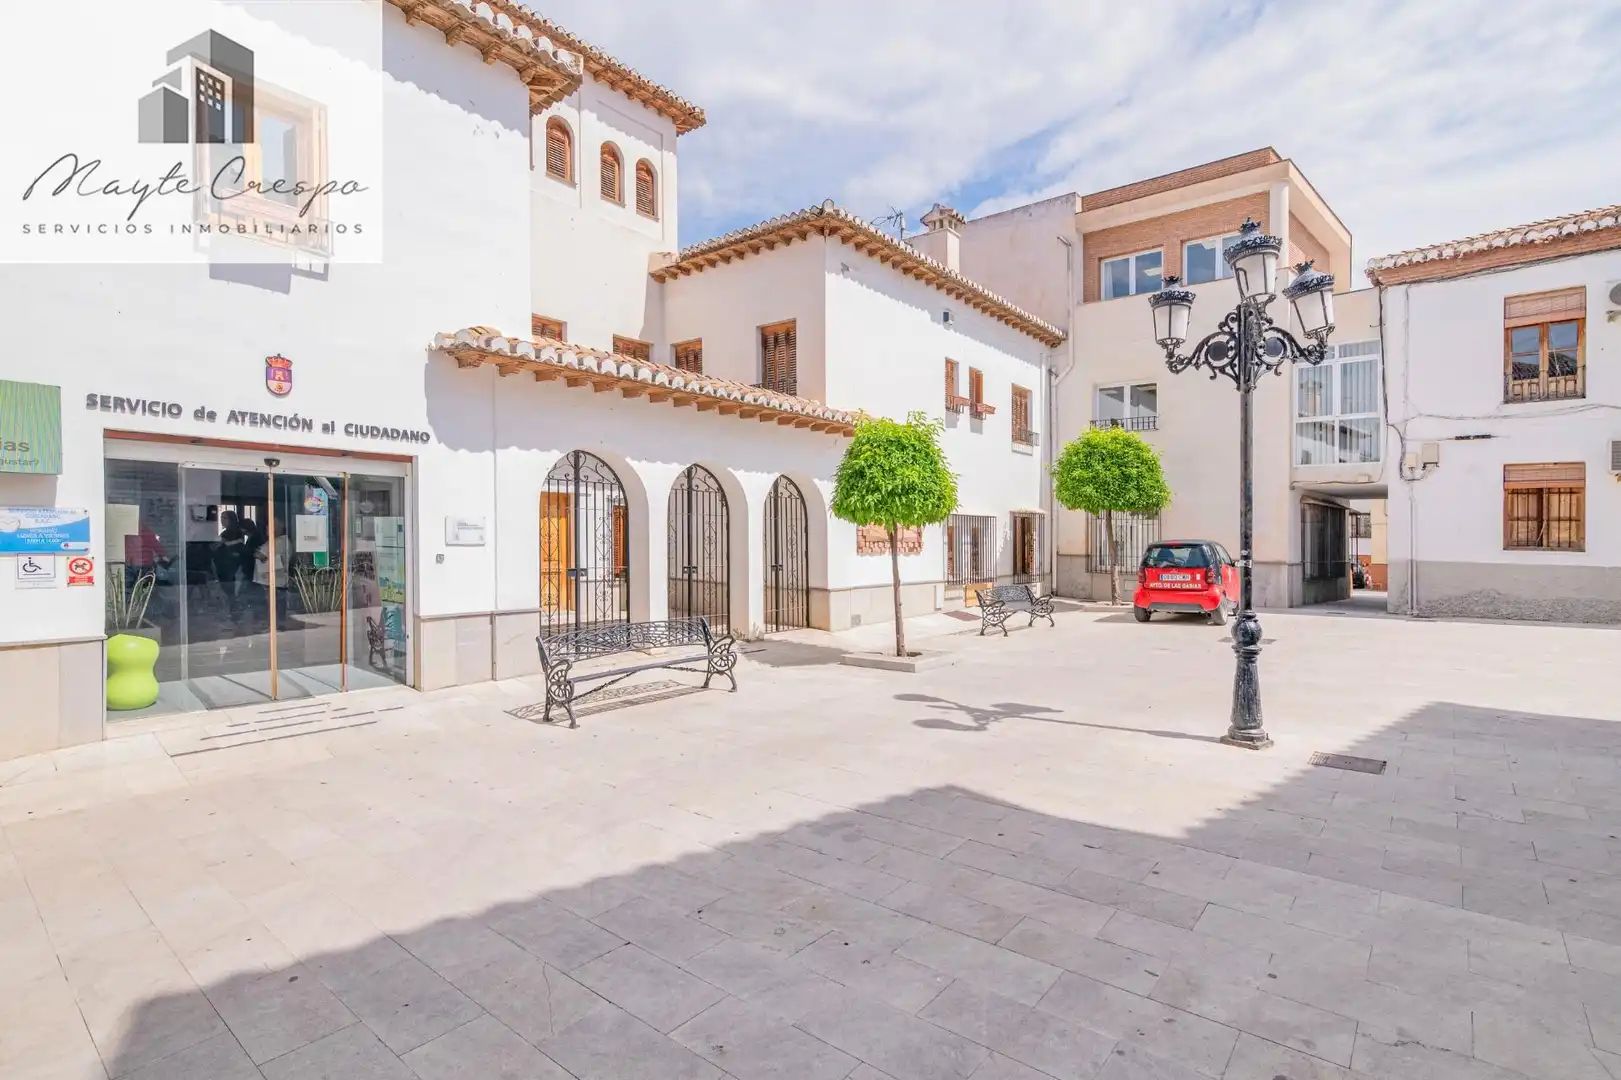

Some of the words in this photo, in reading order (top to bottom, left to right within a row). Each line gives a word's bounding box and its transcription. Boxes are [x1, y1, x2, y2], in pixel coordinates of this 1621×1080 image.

[86, 393, 182, 418] SERVICIO
[193, 406, 217, 422] de
[227, 410, 313, 432] ATENCIÓN
[322, 420, 335, 435] al
[344, 423, 431, 444] CIUDADANO
